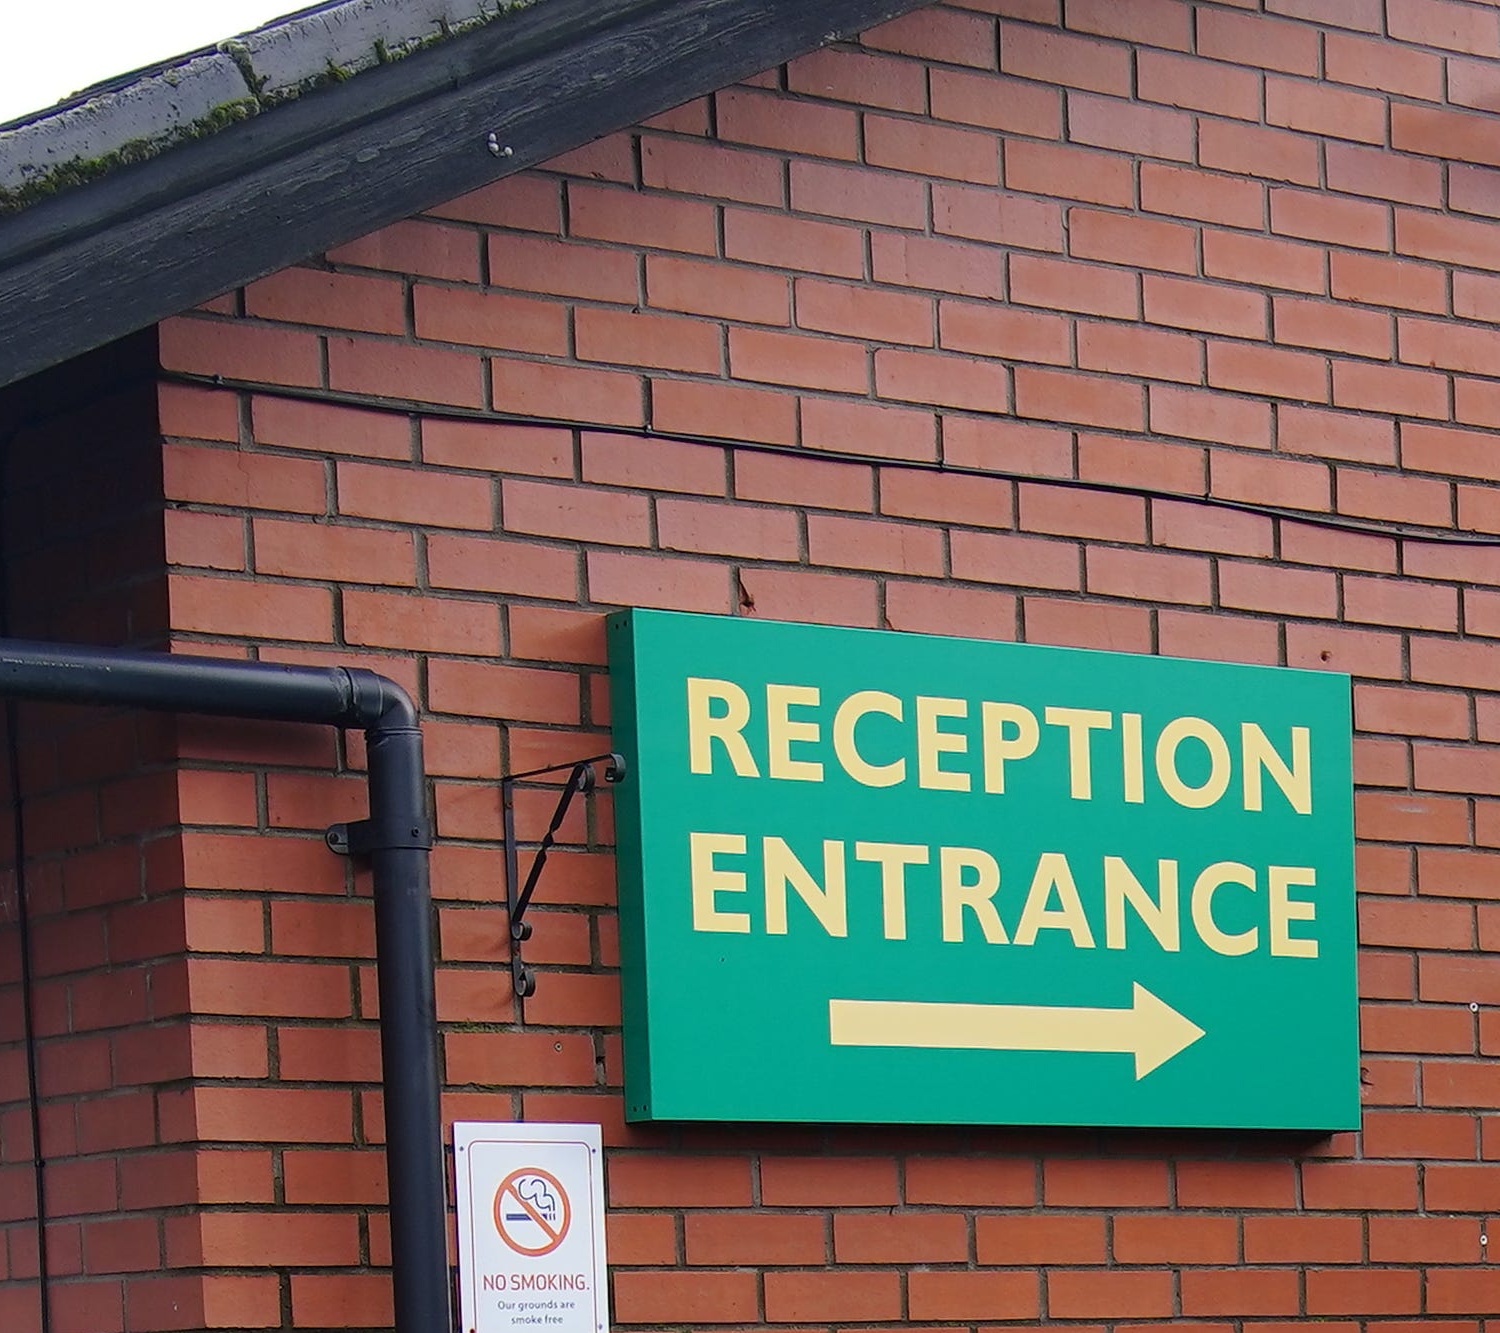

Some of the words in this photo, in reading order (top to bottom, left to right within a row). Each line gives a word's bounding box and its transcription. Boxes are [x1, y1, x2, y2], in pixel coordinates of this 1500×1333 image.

[687, 678, 1312, 815] RECEPTION
[690, 832, 1319, 958] ENTRANCE
[483, 1275, 507, 1290] NO
[511, 1274, 590, 1290] SMOKING.
[498, 1300, 516, 1310] Our
[518, 1300, 558, 1312] grounds
[560, 1301, 574, 1309] are
[511, 1314, 543, 1324] smoke
[544, 1314, 563, 1324] free
